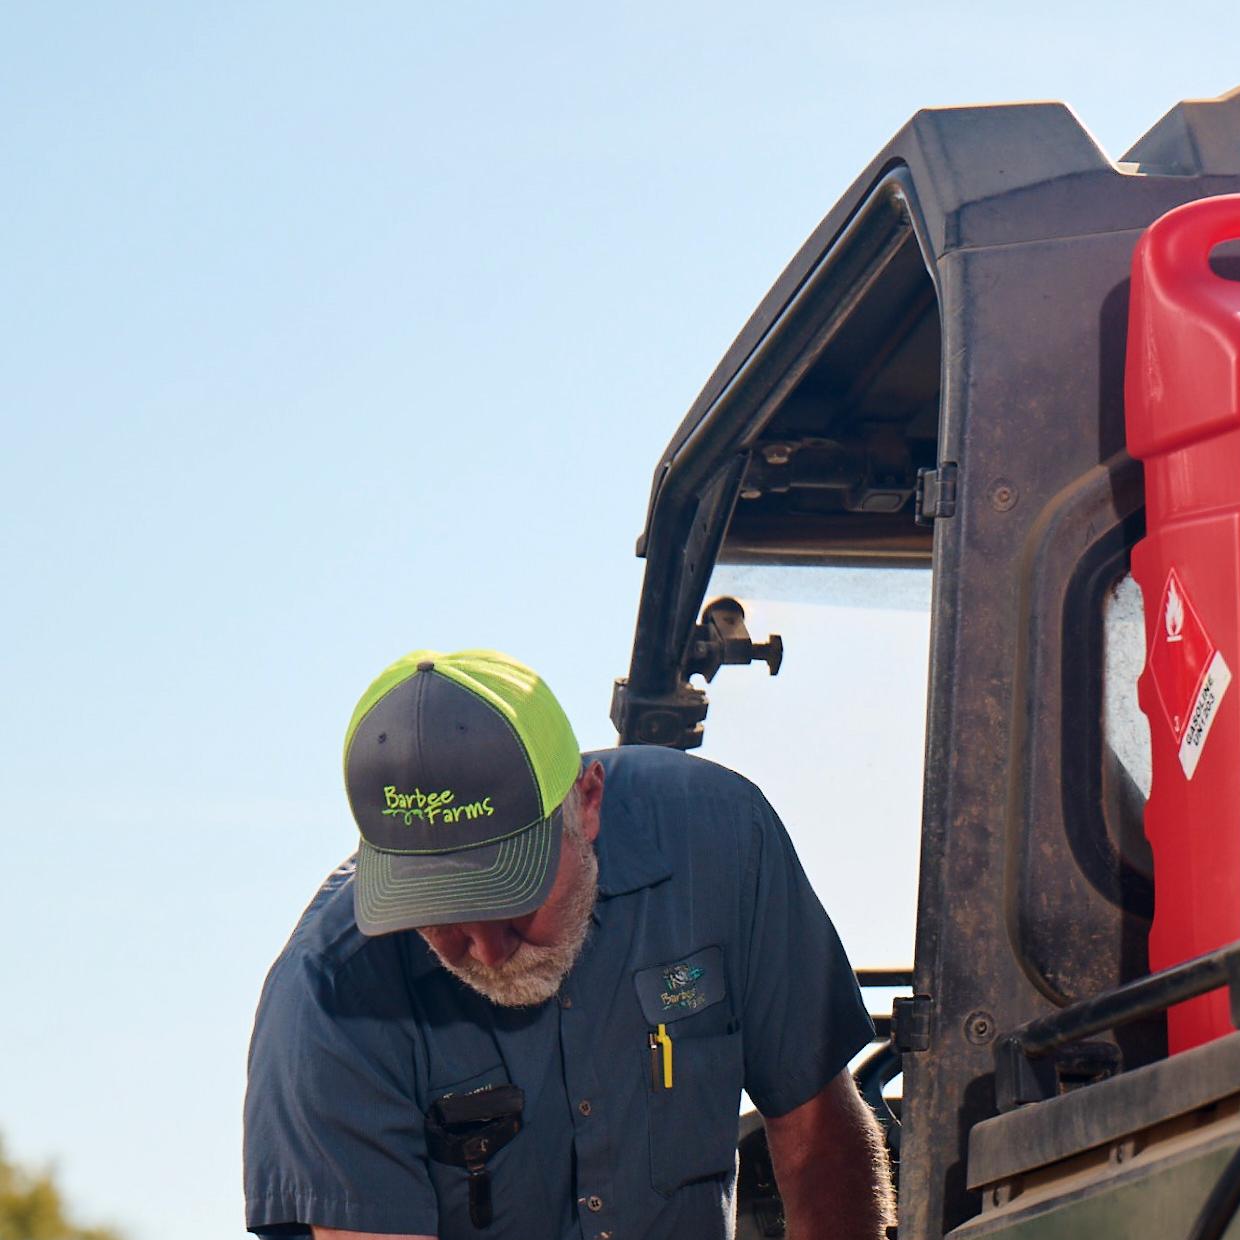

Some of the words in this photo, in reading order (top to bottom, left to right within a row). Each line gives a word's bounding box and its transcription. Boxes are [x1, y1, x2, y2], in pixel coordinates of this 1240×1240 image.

[1186, 675, 1214, 745] GASOLINE
[383, 785, 455, 809] Barbee
[423, 796, 496, 826] Farms
